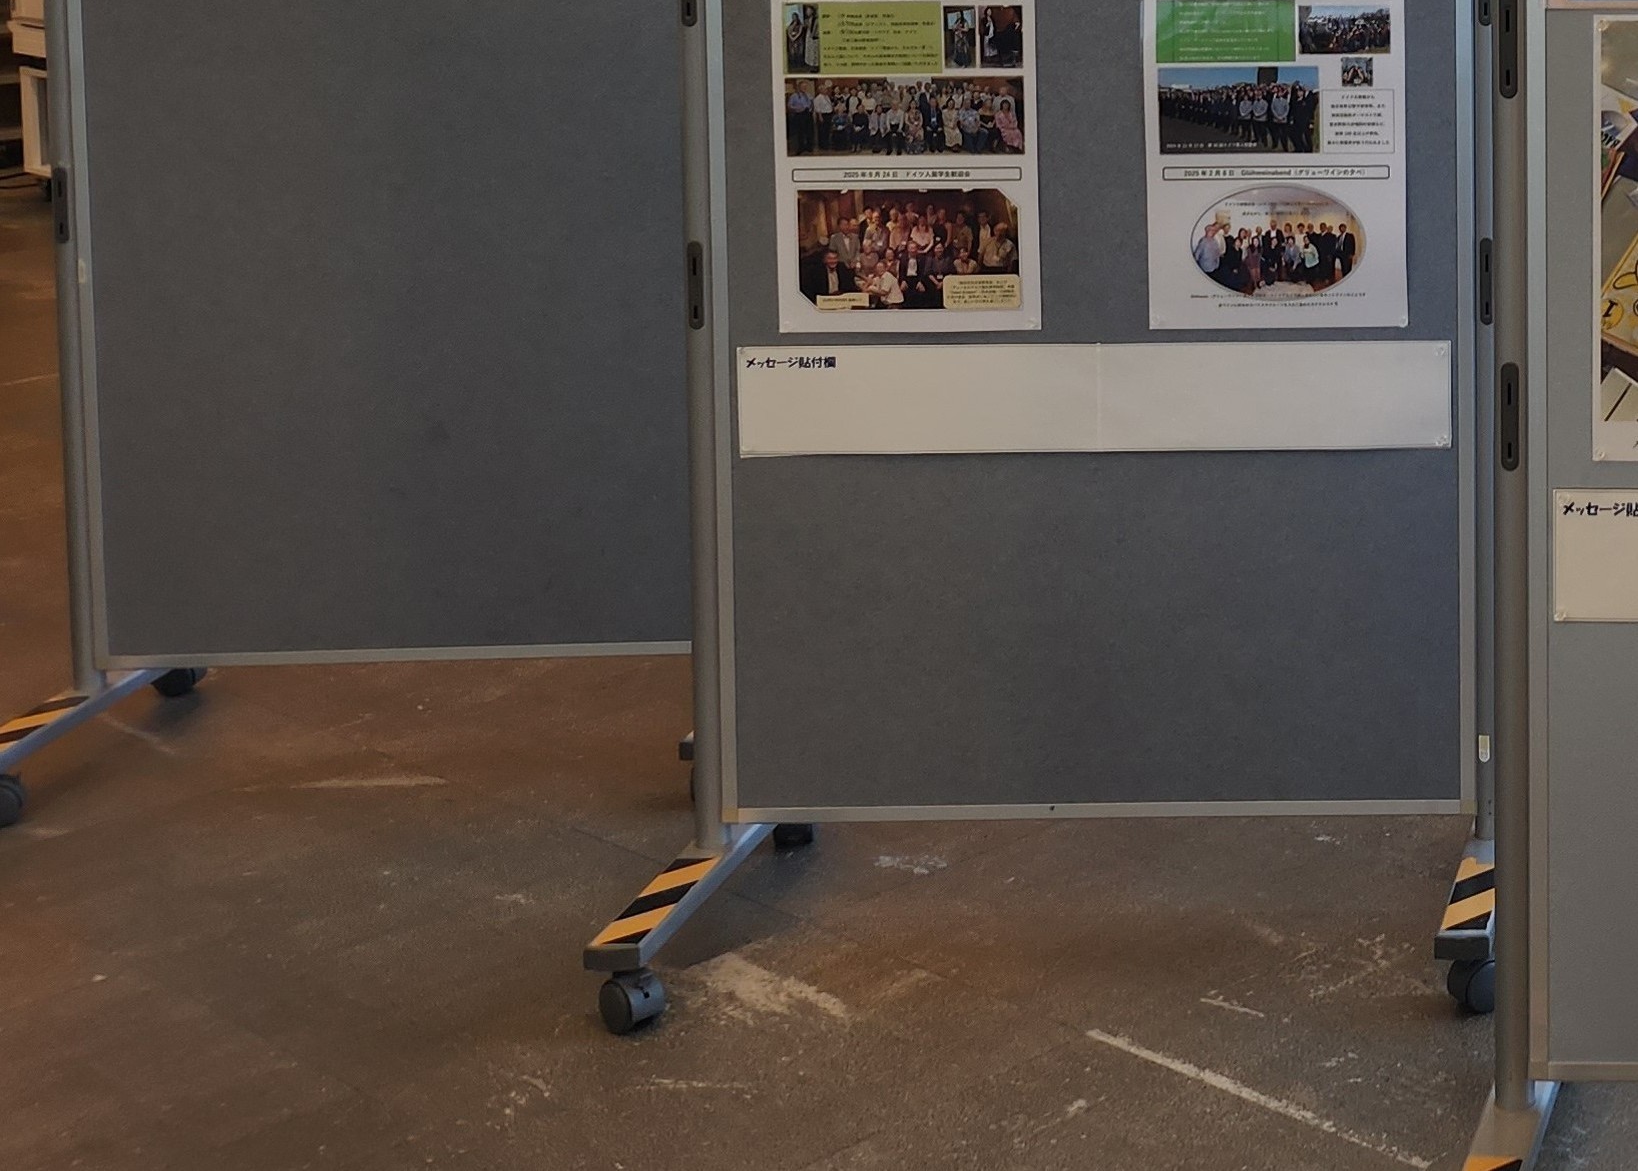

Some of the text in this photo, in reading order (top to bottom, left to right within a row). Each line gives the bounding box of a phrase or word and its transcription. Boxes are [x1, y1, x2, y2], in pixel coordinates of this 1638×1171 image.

[746, 356, 836, 369] メッセージ貼付欄
